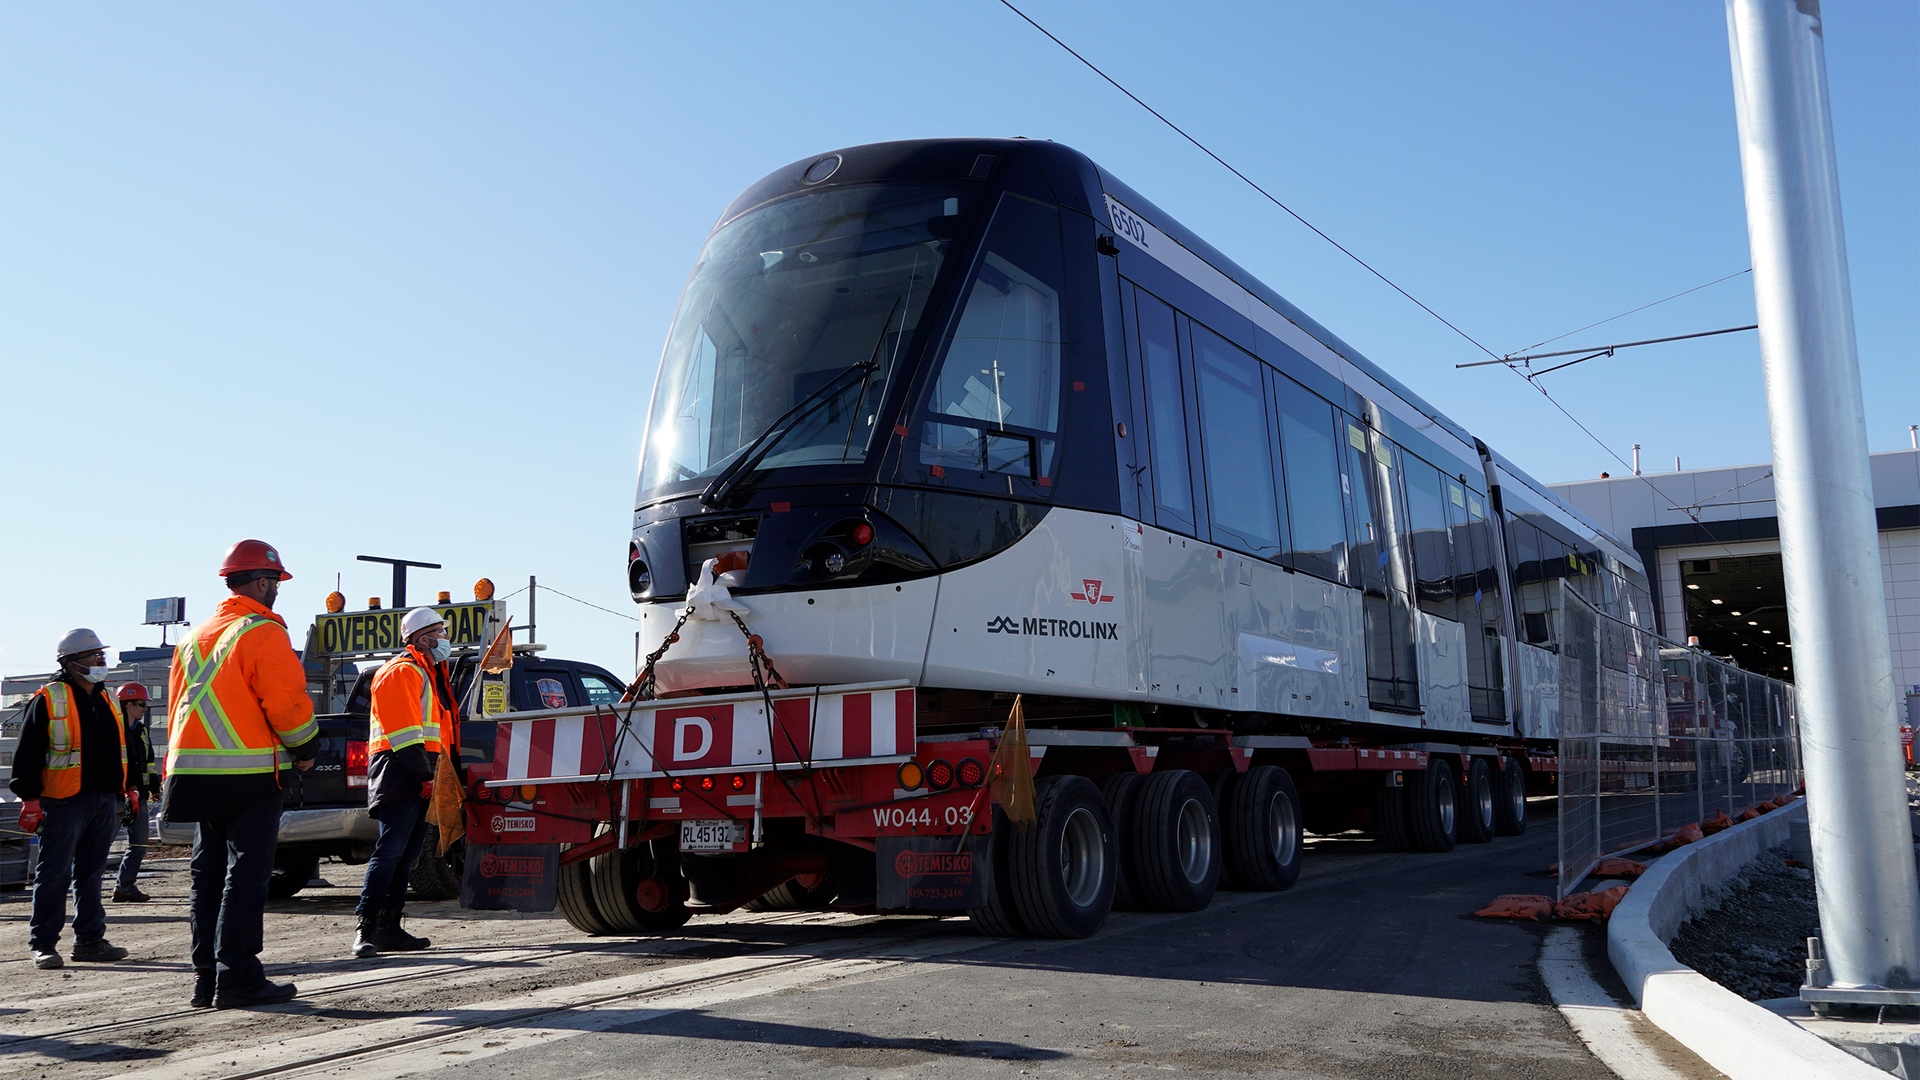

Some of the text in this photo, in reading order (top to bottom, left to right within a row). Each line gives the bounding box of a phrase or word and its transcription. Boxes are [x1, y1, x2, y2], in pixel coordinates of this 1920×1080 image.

[1111, 204, 1149, 248] 6502
[324, 606, 488, 652] OVERSI OAD
[1023, 617, 1118, 640] METROLINX
[673, 716, 713, 762] D
[506, 819, 534, 829] TEMISKO
[499, 859, 541, 873] TEMISKO
[917, 855, 970, 872] TEMISKO
